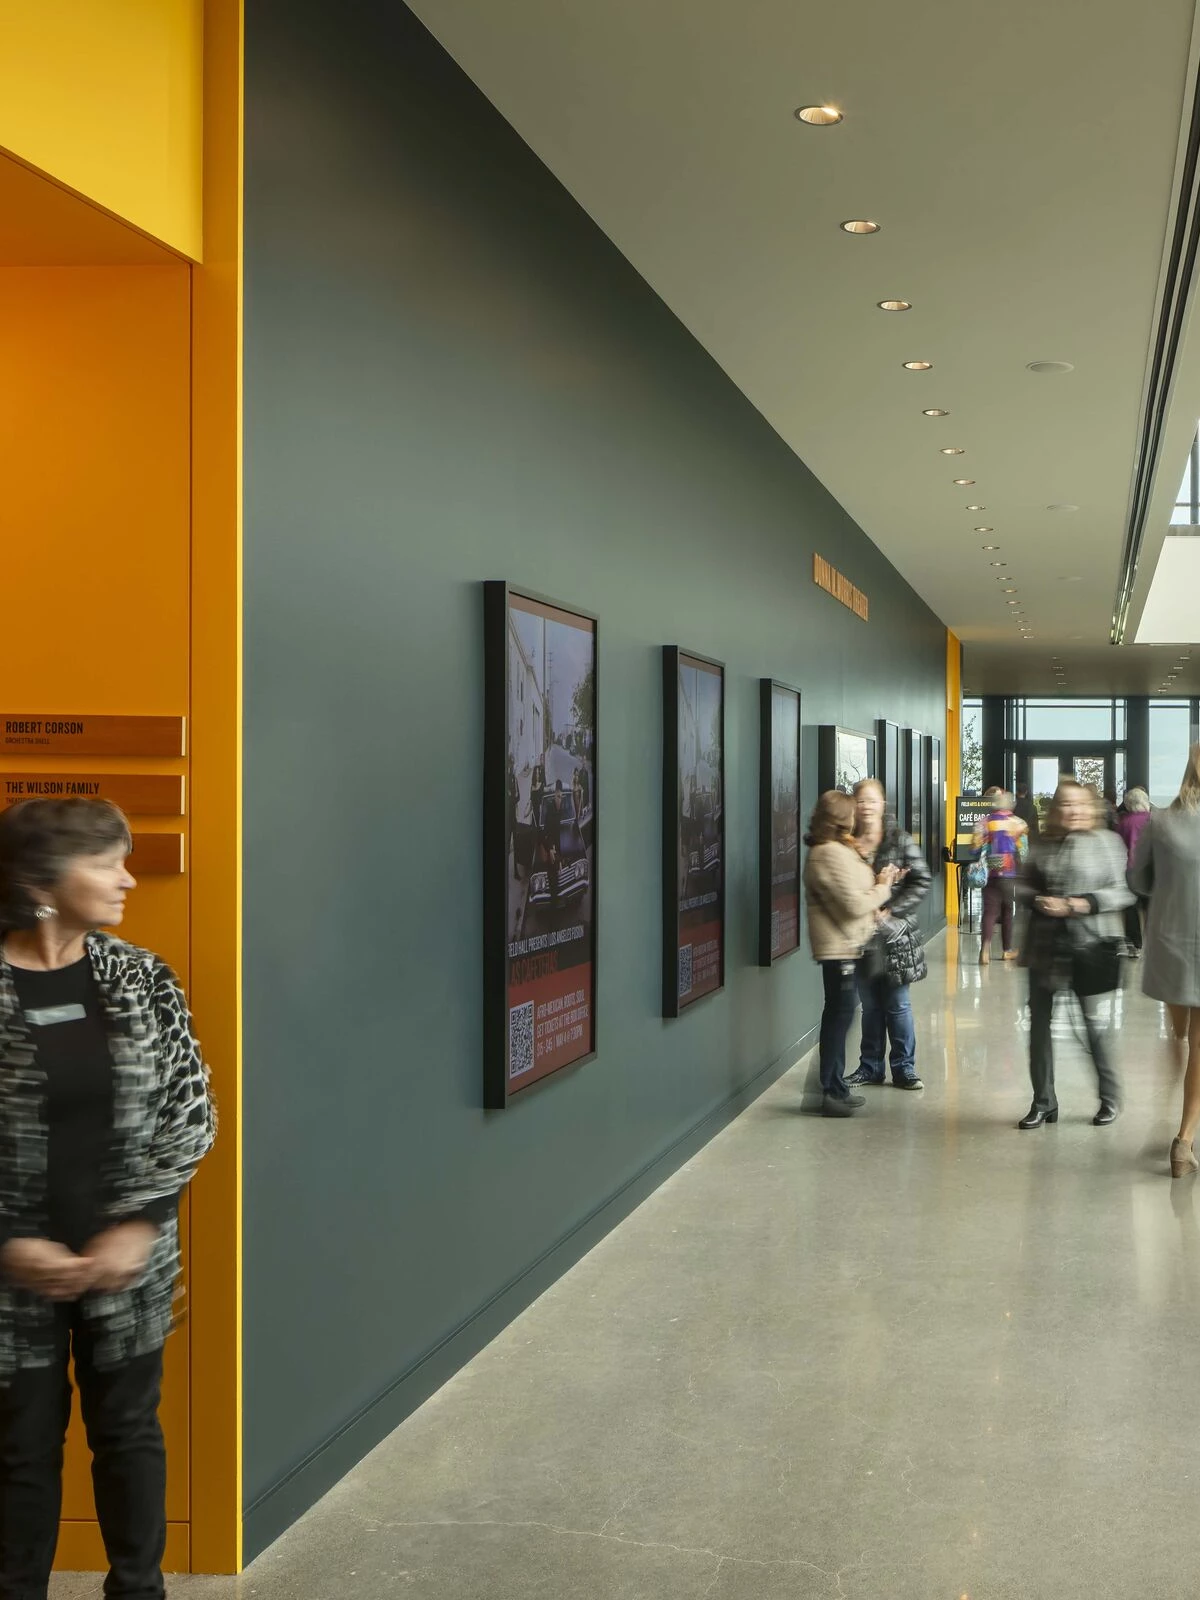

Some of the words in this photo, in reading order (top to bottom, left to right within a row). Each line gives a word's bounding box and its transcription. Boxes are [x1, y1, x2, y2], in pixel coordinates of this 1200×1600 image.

[5, 721, 42, 733] ROBERT
[45, 722, 83, 734] CORSON
[6, 781, 23, 793] THE
[27, 782, 63, 794] WILSON
[66, 782, 100, 794] FAMILY
[959, 812, 973, 821] CAFÉ
